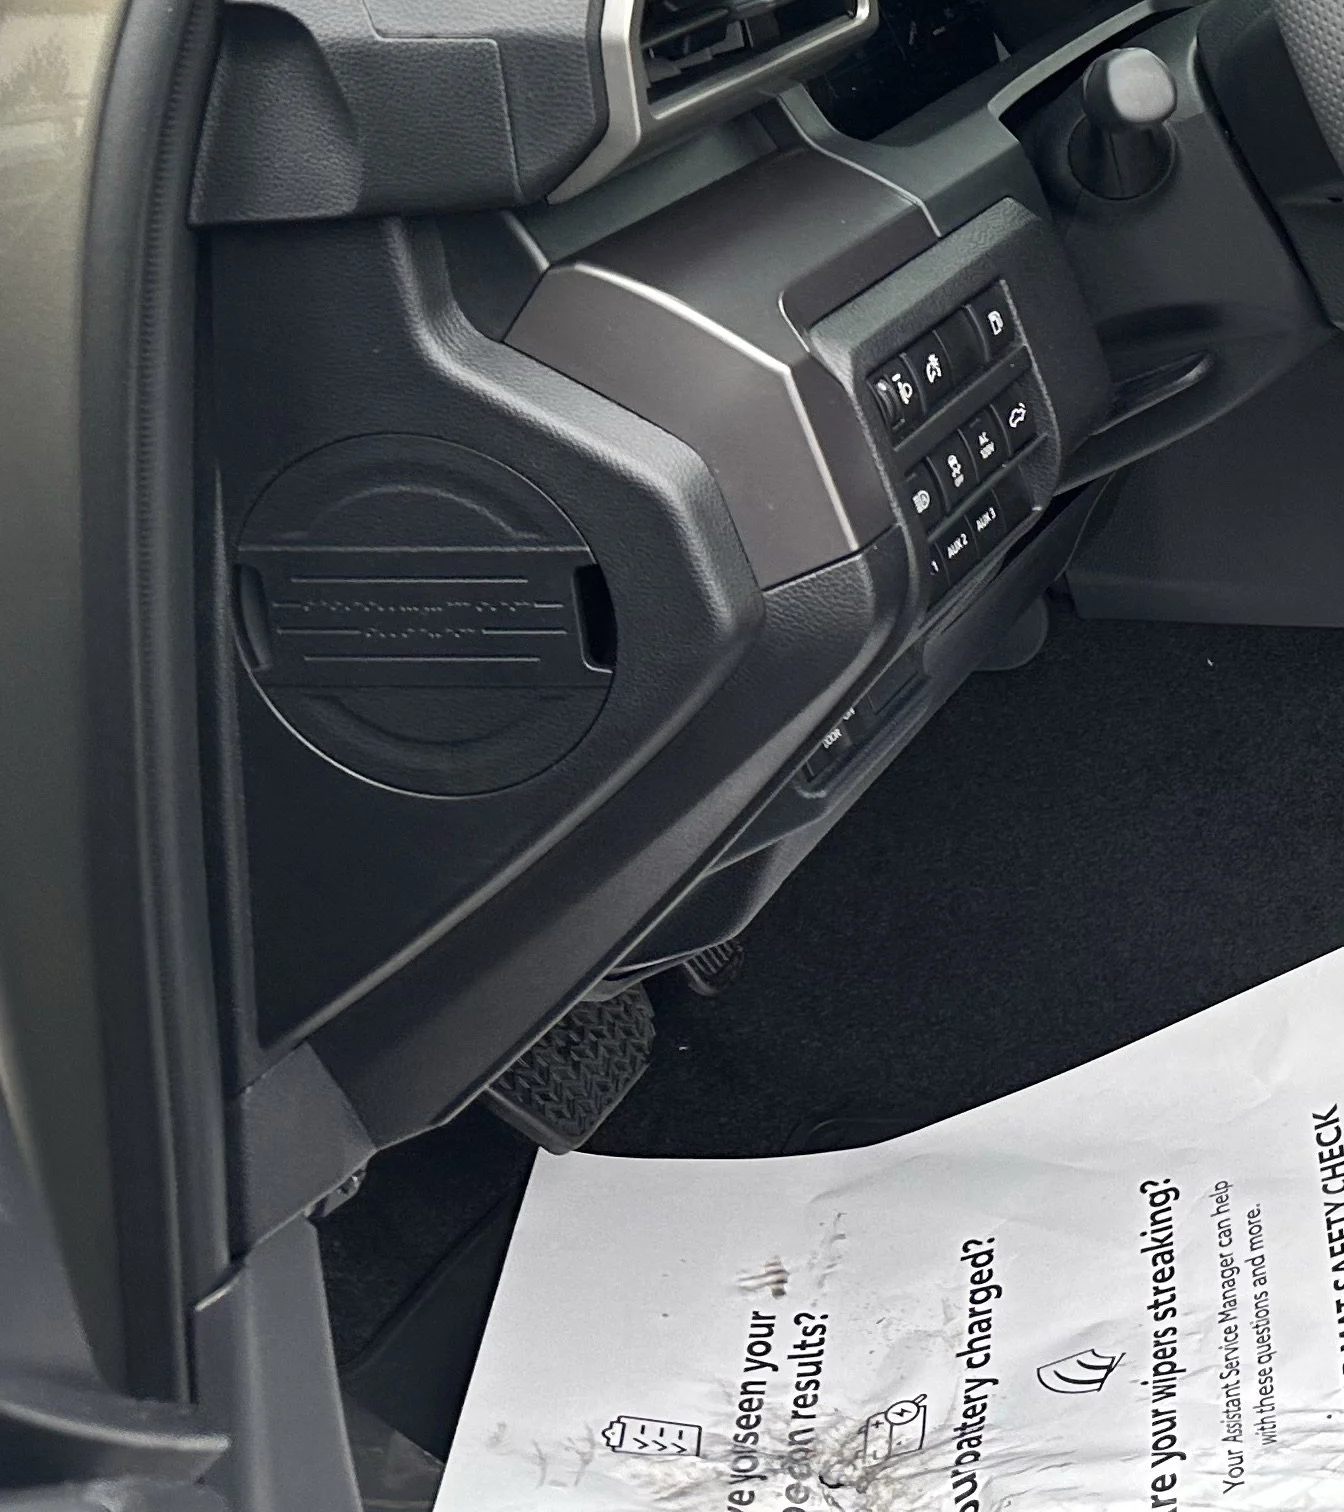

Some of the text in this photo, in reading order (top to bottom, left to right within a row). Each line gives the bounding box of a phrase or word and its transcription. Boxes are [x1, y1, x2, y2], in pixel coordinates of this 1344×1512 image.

[947, 539, 962, 559] AUX
[743, 1310, 779, 1373] your
[955, 1237, 1003, 1369] charged?
[1139, 1178, 1187, 1512] re your wipers streaking?
[1208, 1180, 1245, 1494] Your Assistant Service Manager can help
[1244, 1203, 1277, 1446] with these questions and more.
[733, 1380, 767, 1445] seen
[787, 1312, 829, 1420] results?
